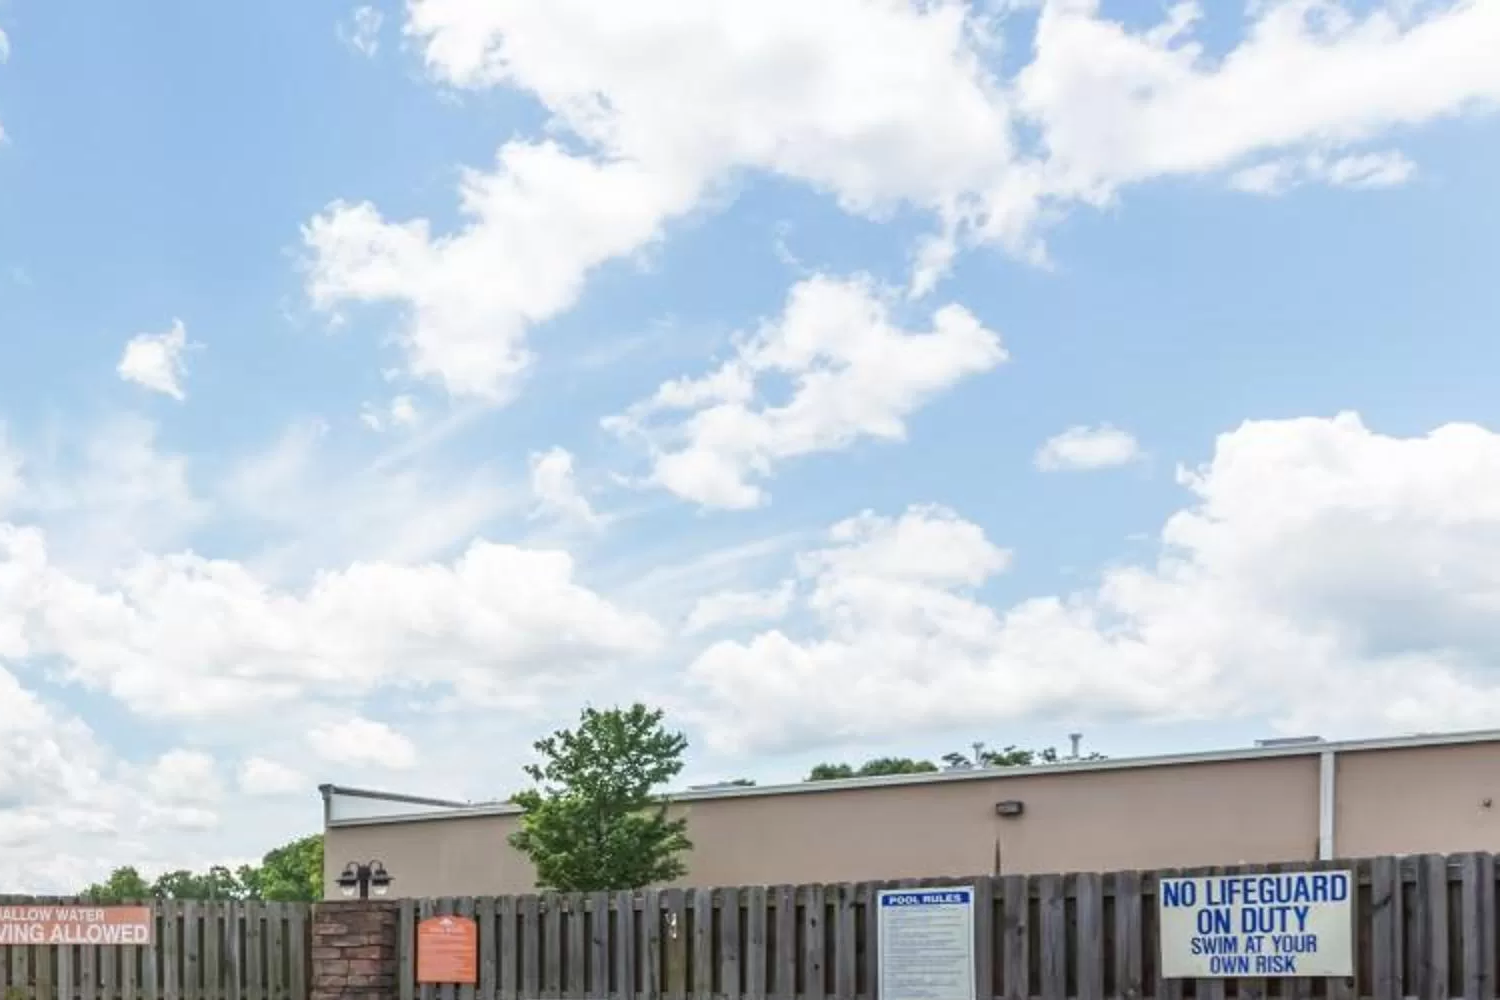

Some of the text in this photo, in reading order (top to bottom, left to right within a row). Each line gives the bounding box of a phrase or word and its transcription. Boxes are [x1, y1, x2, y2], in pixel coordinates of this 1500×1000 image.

[889, 893, 962, 905] POOL RULES
[1163, 874, 1347, 907] NO LIFEGUARD
[55, 907, 105, 921] WATER
[1197, 906, 1310, 934] ON DUTY
[49, 923, 149, 943] ALLOWED
[1190, 933, 1318, 955] SWIM AT YOUR
[1210, 955, 1297, 974] OWN RISK
